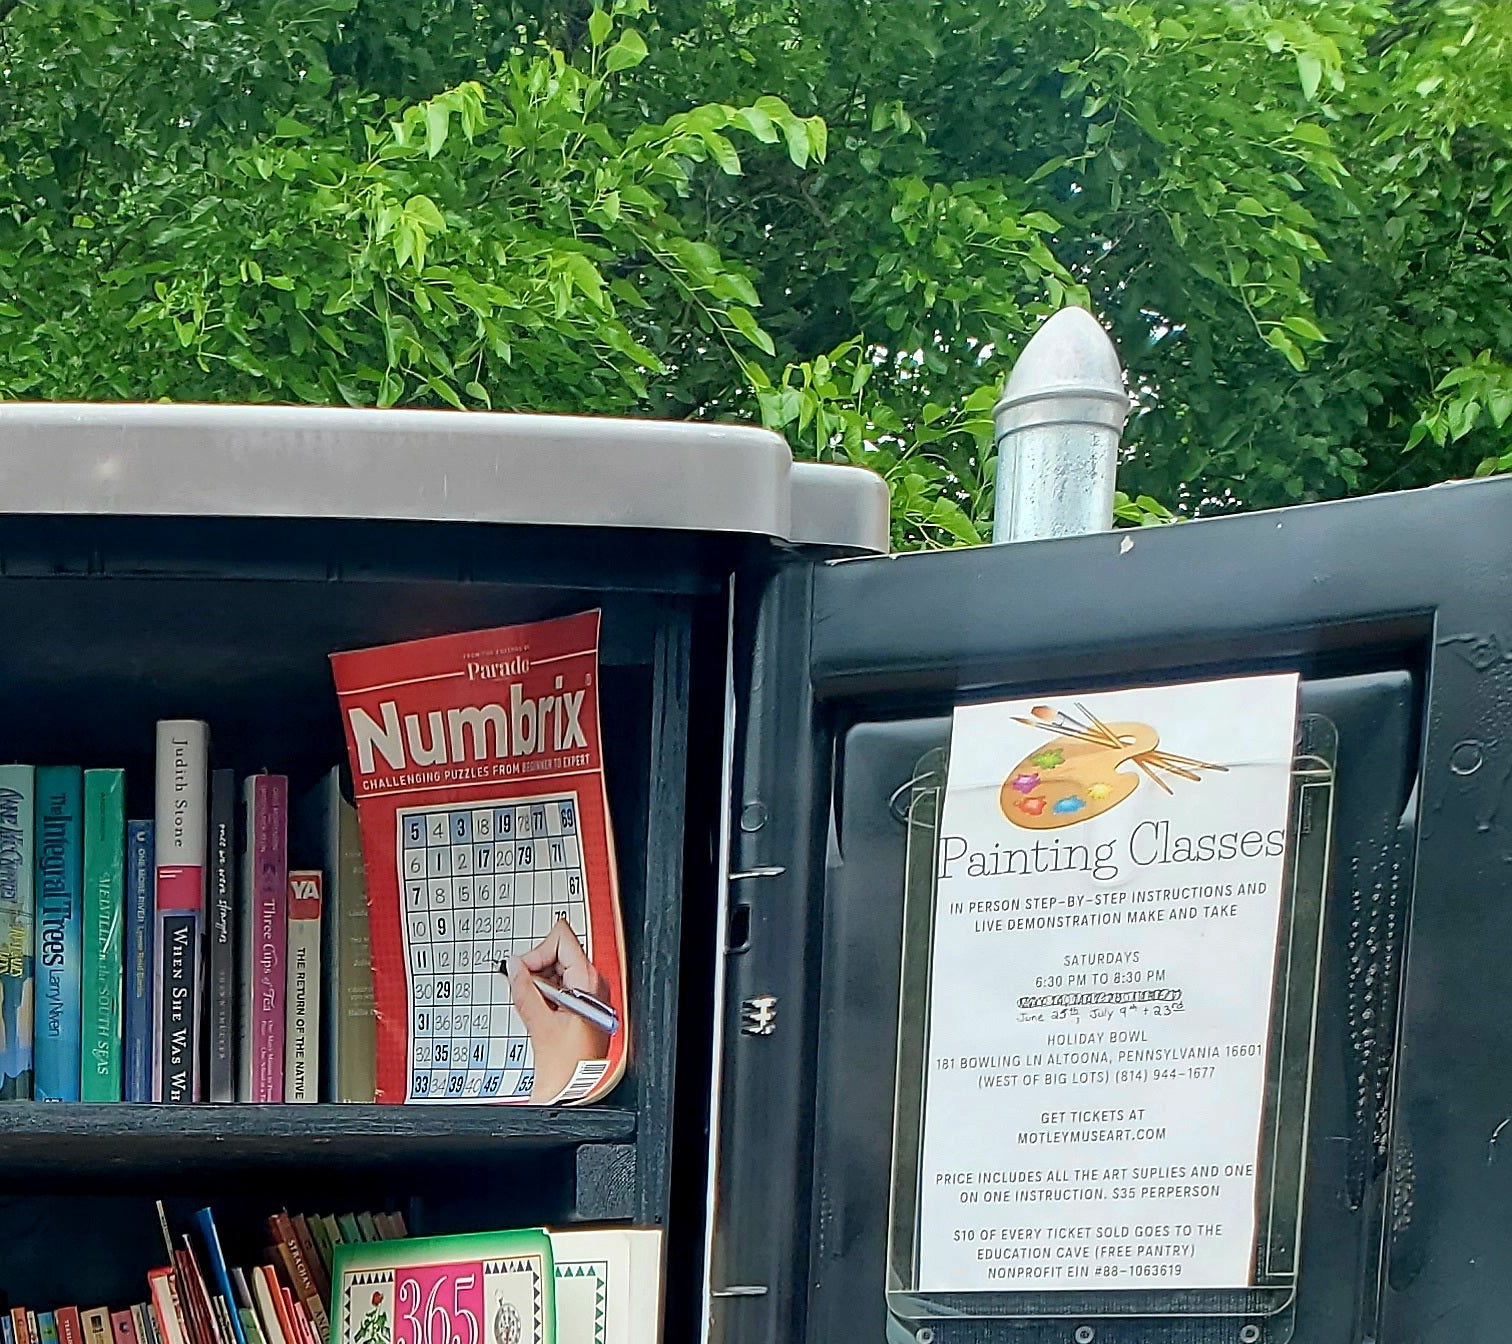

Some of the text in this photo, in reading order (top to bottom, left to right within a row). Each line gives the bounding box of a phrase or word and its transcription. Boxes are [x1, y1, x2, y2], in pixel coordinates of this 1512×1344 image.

[467, 656, 530, 681] Parade
[348, 676, 587, 774] Numbrix
[363, 771, 440, 790] CHALLENGING
[445, 766, 489, 780] PUZZLES
[493, 764, 519, 776] FROM
[563, 753, 590, 768] EXPERT
[172, 738, 188, 848] Judith Stone
[938, 821, 1286, 880] Painting Classes
[39, 793, 72, 967] The Integral Trees
[291, 881, 319, 899] YA
[951, 882, 1267, 915] IN PERSON STEP-BY-STEP INSTRUCTIONS AND
[975, 905, 1238, 932] LIVE DEMONSTRATION MAKE AND TAKE
[1064, 952, 1140, 966] SATURDAYS
[1036, 970, 1165, 987] 6:30 PM TO 8:30 PM
[45, 969, 64, 1037] Larry Niven
[171, 927, 188, 1066] WHEN SHE WAS
[296, 948, 306, 1099] THE RETURN OF THE NATIVE
[1017, 1013, 1044, 1022] June
[1089, 1009, 1113, 1021] July
[1153, 1002, 1185, 1016] 23rd
[1048, 1031, 1148, 1046] HOLIDAY BOWL
[936, 1044, 1262, 1070] 181 BOWLING LN ALTOONA, PENNSYLVANIA 16601
[978, 1067, 1215, 1089] (WEST OF BIG LOTS) (814) 944-1677
[1041, 1109, 1145, 1124] GET TICKETS AT
[1018, 1128, 1166, 1144] MOTLEYMUSEART.COM
[954, 1224, 1223, 1242] $10 OF EVERY TICKET SOLD GOES TO THE
[977, 1244, 1196, 1261] EDUCATION CAVE (FREE PANTRY)
[987, 1264, 1182, 1279] NONPROFIT EIN #88-1063619
